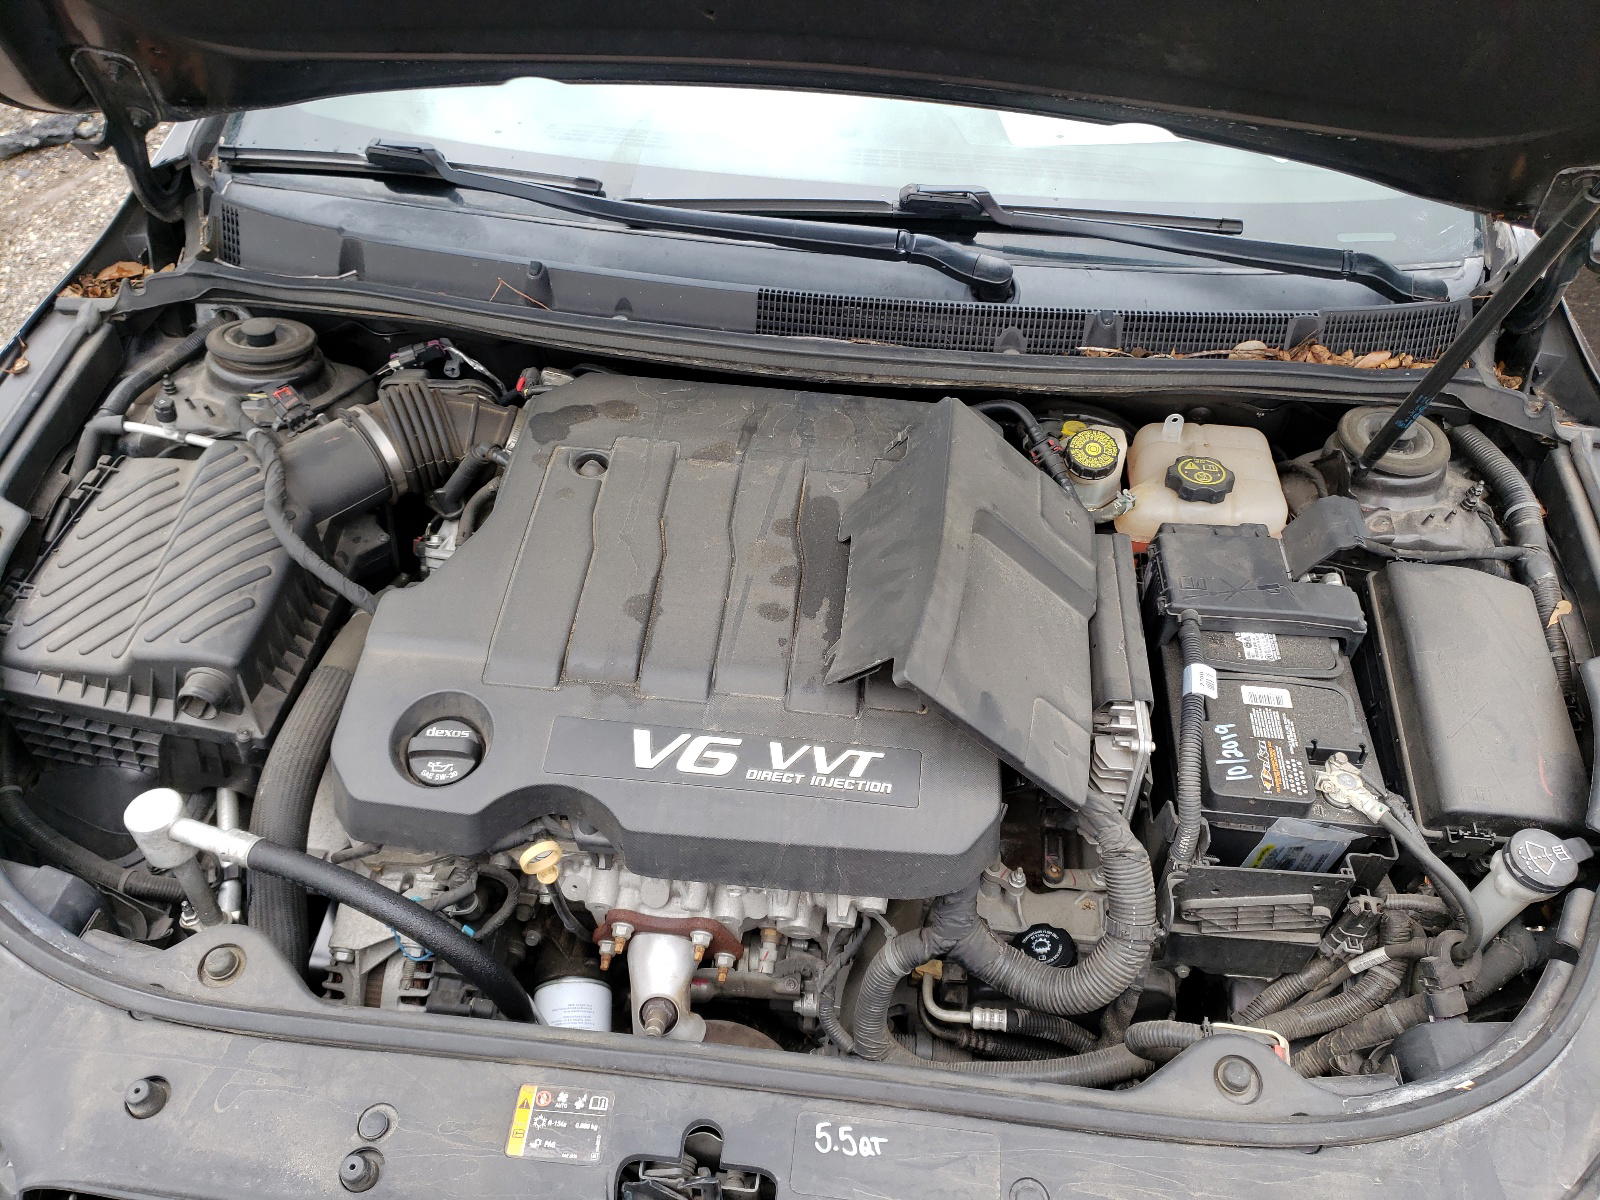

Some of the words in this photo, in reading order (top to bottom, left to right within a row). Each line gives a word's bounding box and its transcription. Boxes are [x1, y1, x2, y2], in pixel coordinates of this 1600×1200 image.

[426, 727, 472, 737] dexos
[633, 728, 743, 776] V6
[769, 741, 886, 778] VVT
[1215, 722, 1254, 781] 10/2019
[421, 770, 435, 779] SAE
[435, 770, 458, 780] 5W-30
[745, 769, 806, 785] DIRECT
[810, 776, 893, 794] INJECTION
